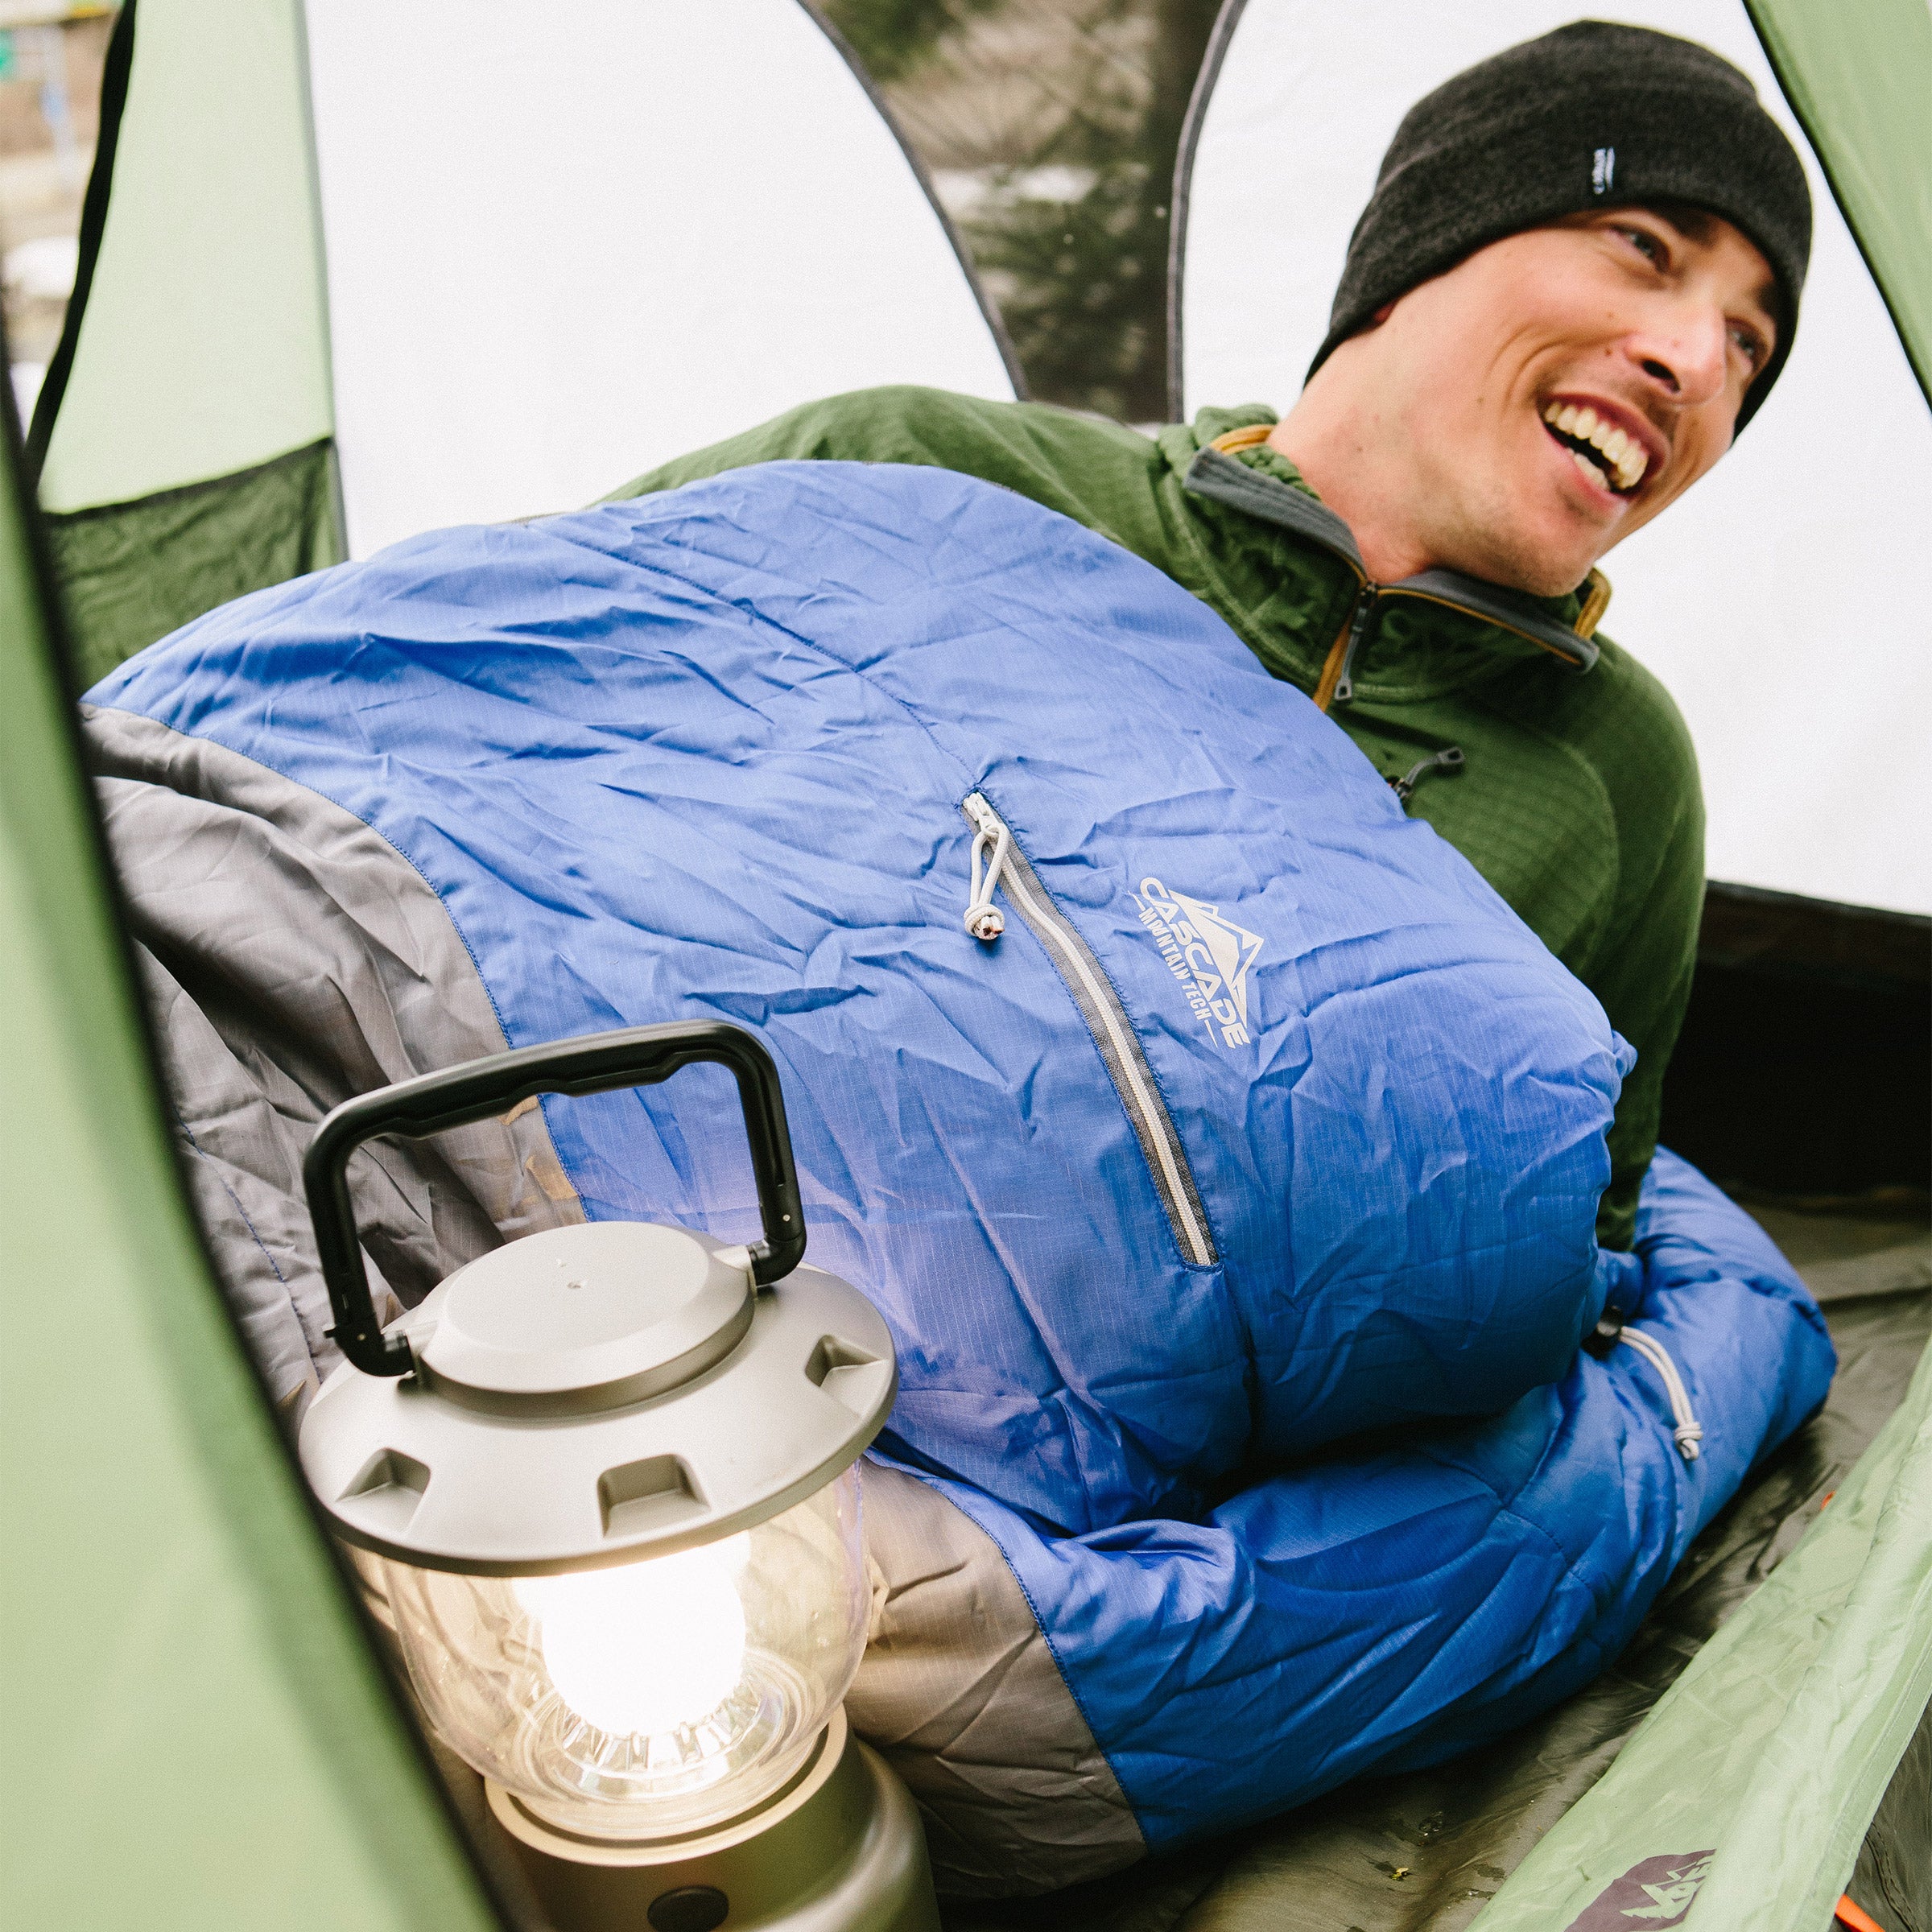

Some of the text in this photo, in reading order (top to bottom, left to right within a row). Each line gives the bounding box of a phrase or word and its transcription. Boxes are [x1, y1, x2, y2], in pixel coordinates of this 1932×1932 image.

[1138, 906, 1212, 1020] MOUNTAIN TECH
[1140, 877, 1251, 1049] CASCADE
